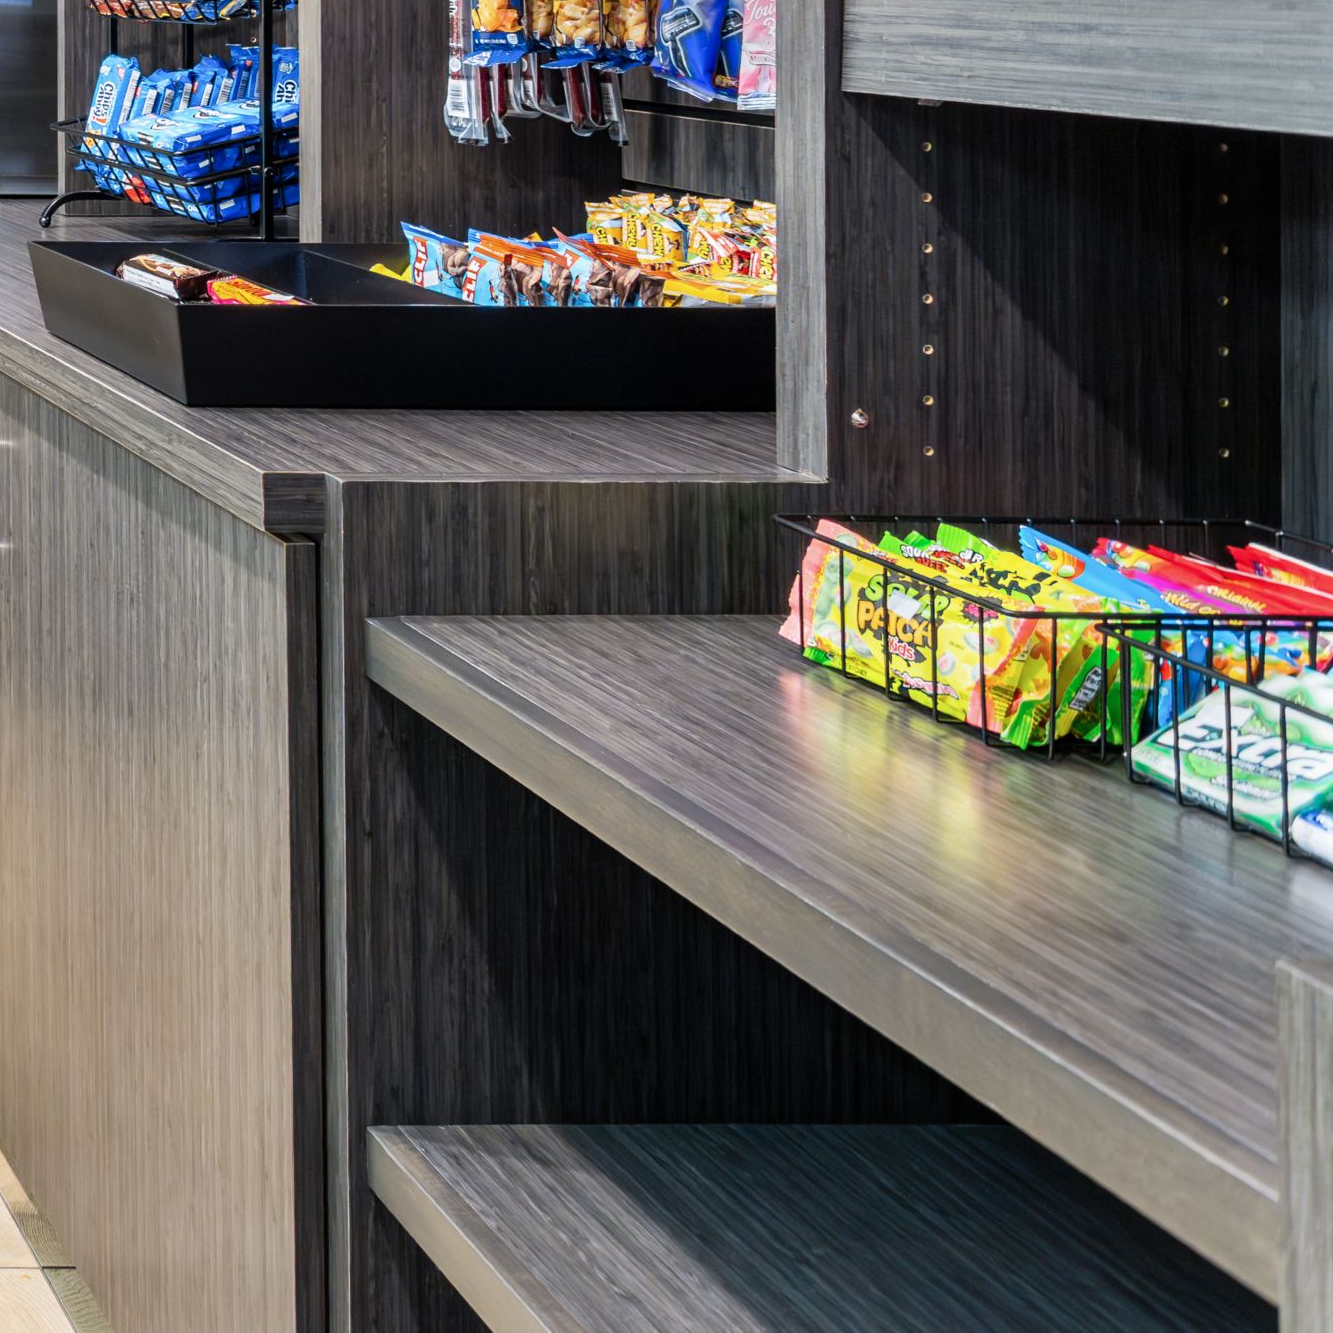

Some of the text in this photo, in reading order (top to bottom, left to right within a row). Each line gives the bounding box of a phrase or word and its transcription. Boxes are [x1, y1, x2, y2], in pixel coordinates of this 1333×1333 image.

[414, 237, 428, 287] CLIF
[462, 258, 483, 303] CLIF
[887, 636, 916, 660] Kids
